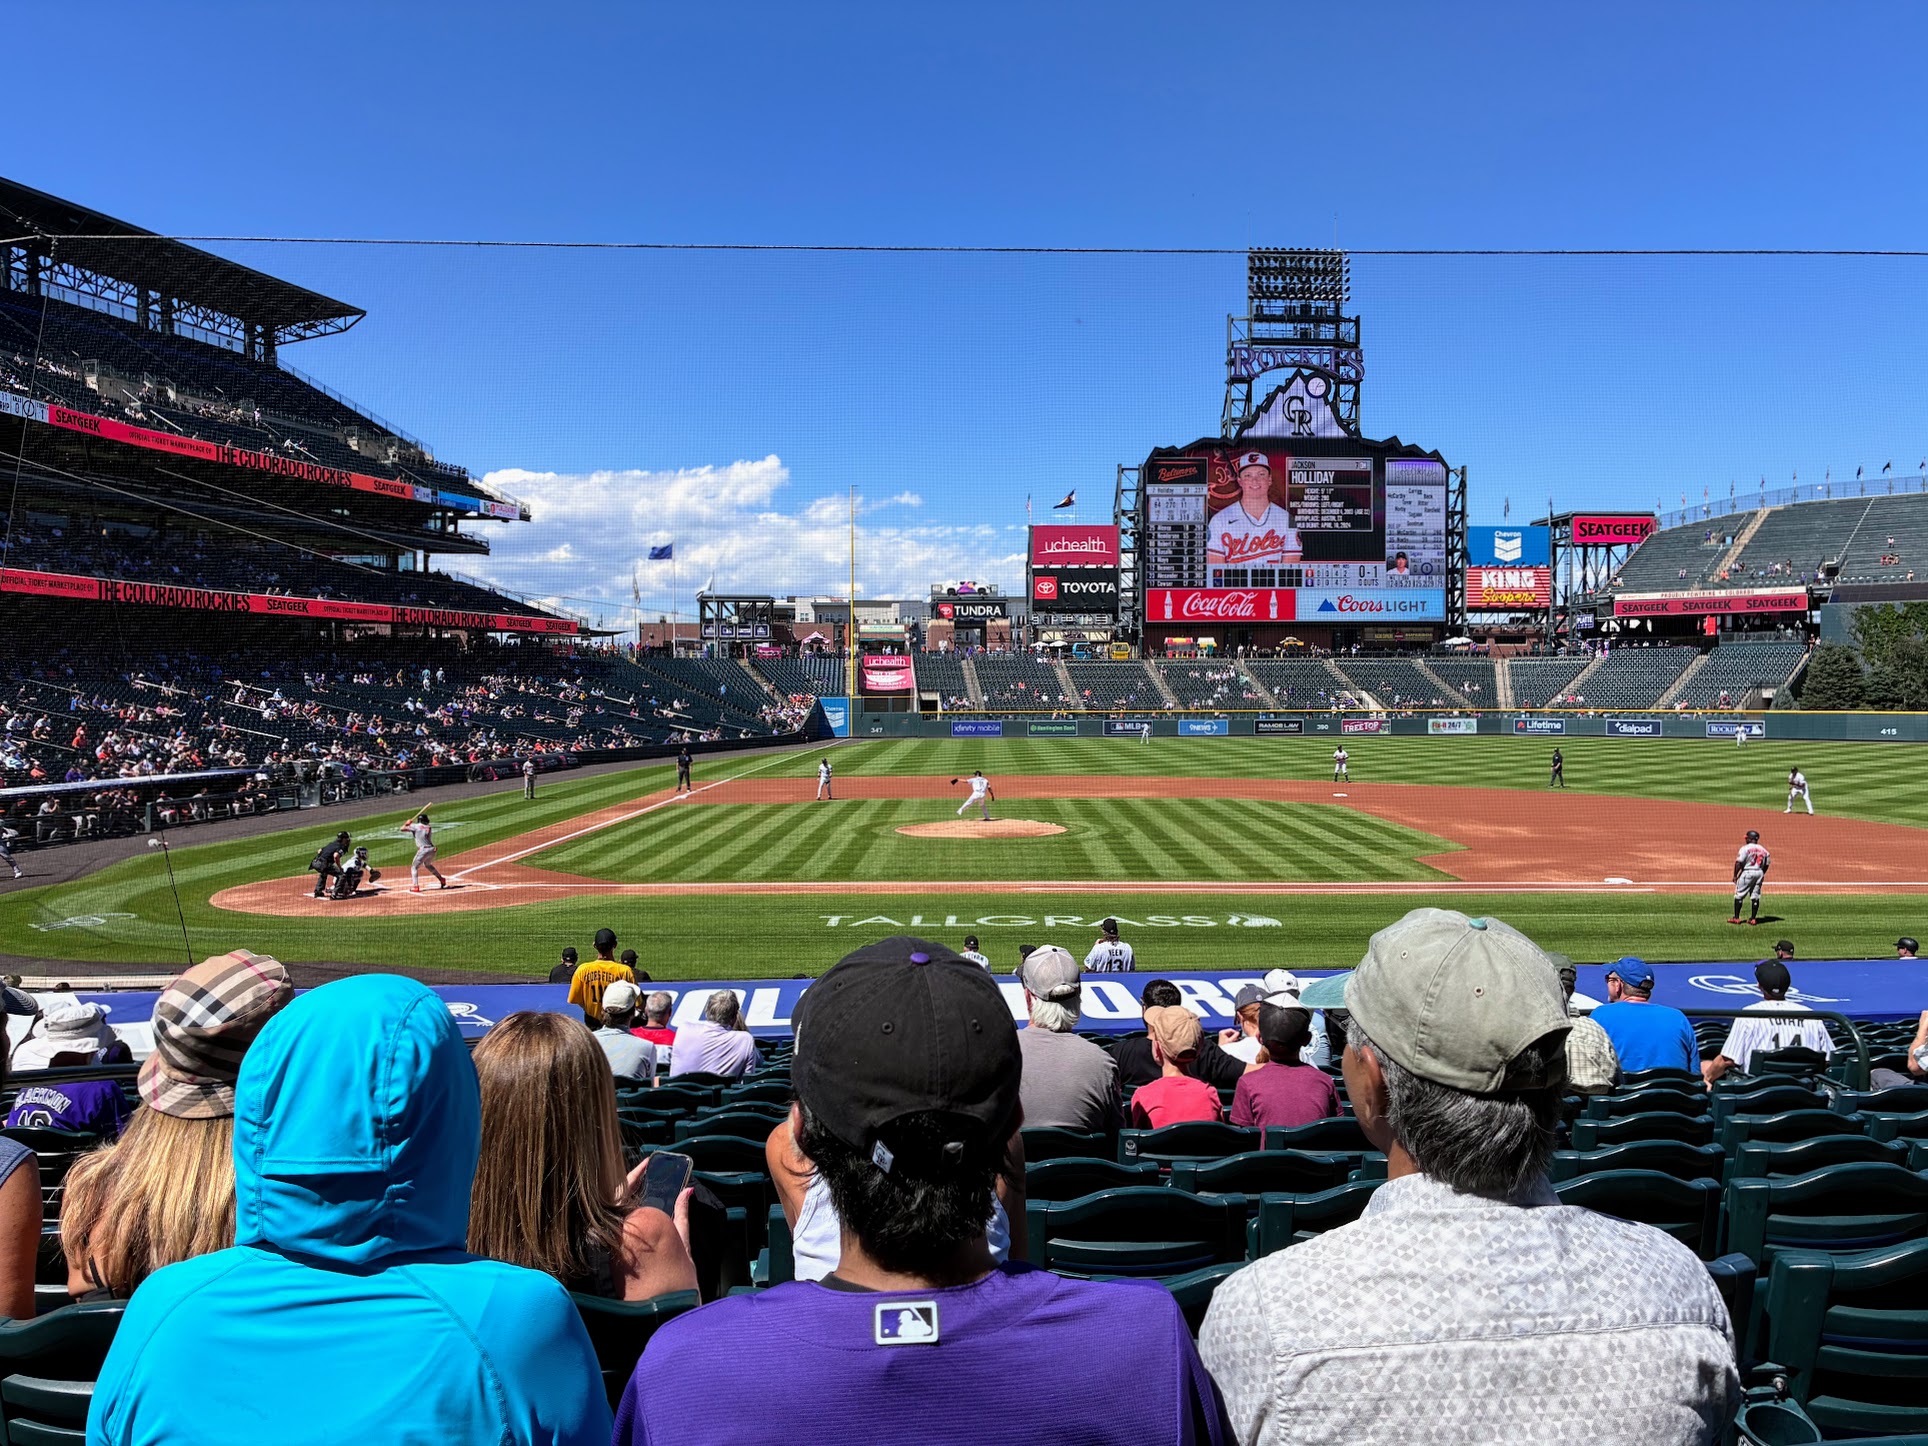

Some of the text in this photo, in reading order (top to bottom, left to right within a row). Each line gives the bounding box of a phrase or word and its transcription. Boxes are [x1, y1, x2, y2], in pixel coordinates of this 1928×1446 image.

[1232, 347, 1365, 381] ROCKIES
[55, 410, 101, 433] SEATGEEK
[128, 431, 352, 487] OFFICIAL TICKET MARKETPLACE OF THE COLORADO ROCKIES
[1291, 461, 1316, 469] JACKSON
[1158, 466, 1198, 481] Baltimore
[1291, 471, 1335, 484] HOLLIDAY
[373, 479, 407, 497] SEATGEEK
[1578, 522, 1652, 537] SEATGEEK
[1045, 536, 1106, 552] uchealth
[1482, 570, 1536, 588] KING
[1, 575, 251, 612] OFFICIAL TICKET MARKETPLACE OF THE COLORADO ROCKIES
[1061, 582, 1117, 593] TOYOTA
[1338, 595, 1427, 612] Coors LIGHT
[1482, 588, 1536, 604] Soopers
[1746, 598, 1799, 609] SEATGEEK
[266, 599, 309, 614] SEATGEEK
[954, 605, 1002, 616] TUNDRA
[1182, 592, 1258, 617] Coca-Cola
[1622, 602, 1670, 613] SEATGEEK
[1682, 601, 1732, 611] SEATGEEK
[392, 606, 408, 621] THE
[409, 608, 459, 627] COLORADO
[461, 611, 497, 629] ROCKIES
[506, 618, 533, 629] SEATGEEK
[545, 621, 571, 632] SEATGEEK
[869, 656, 906, 666] uchealth
[954, 724, 1001, 733] xfinity mobile
[1527, 721, 1562, 729] Lifetime
[1619, 722, 1652, 734] dialpad
[819, 915, 1219, 928] TALLGRASS
[15, 1087, 72, 1114] BLACKMON
